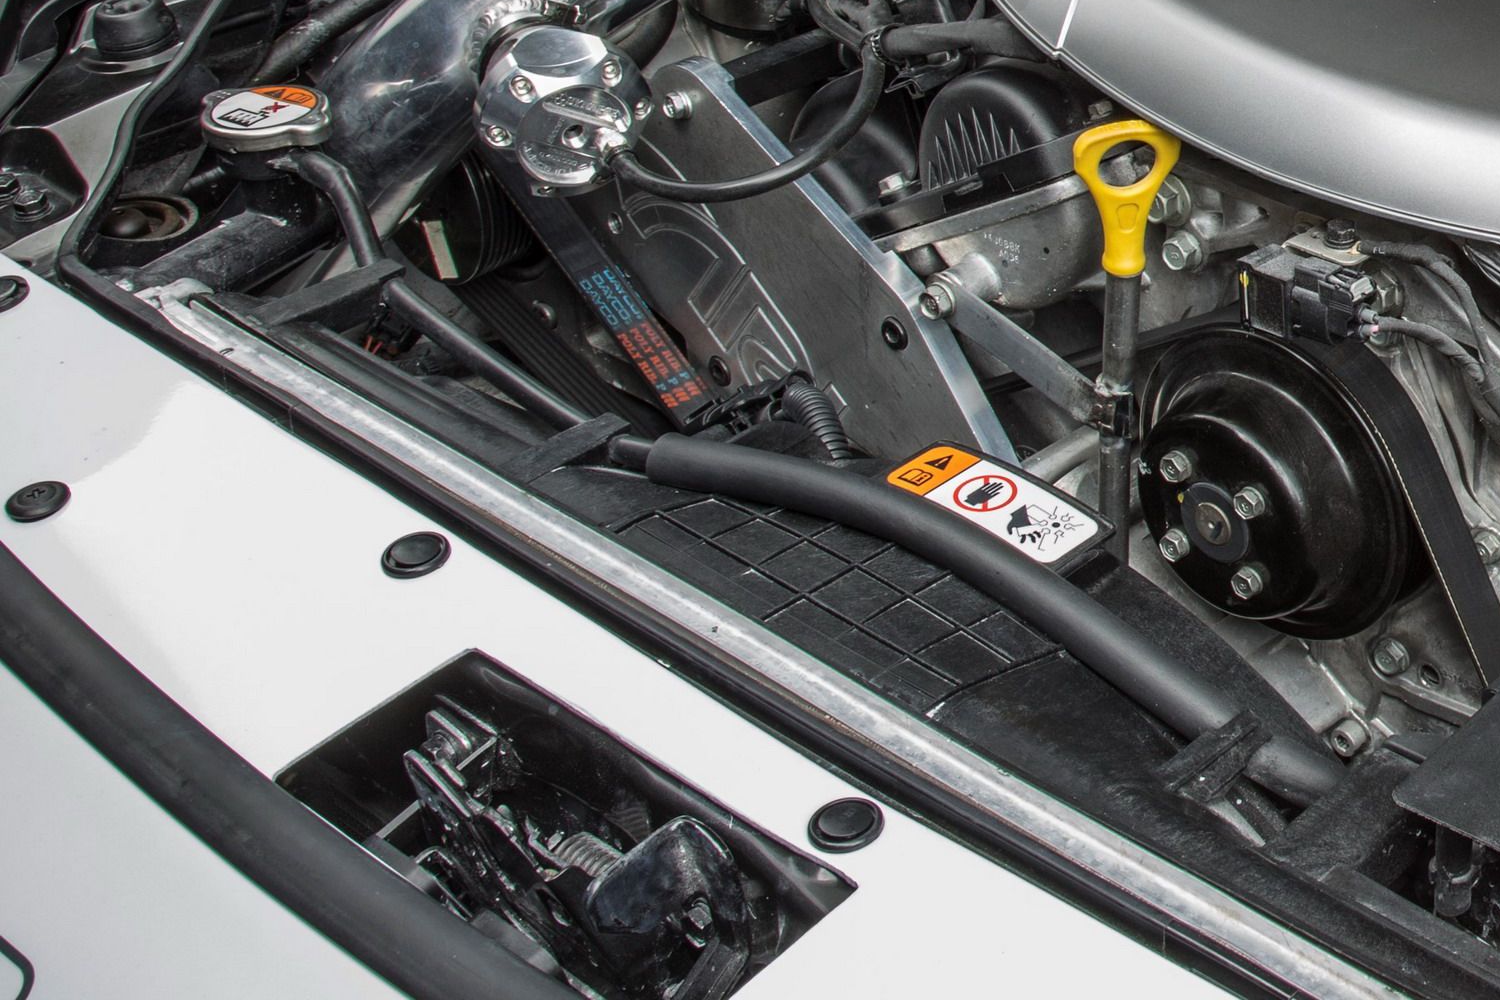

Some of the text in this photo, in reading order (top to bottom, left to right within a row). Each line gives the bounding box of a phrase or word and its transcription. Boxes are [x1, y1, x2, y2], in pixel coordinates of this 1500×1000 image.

[579, 279, 619, 326] DAYCO
[616, 332, 642, 359] POLY
[591, 273, 631, 321] DAYCO
[629, 327, 655, 354] POLY
[640, 320, 666, 348] POLY
